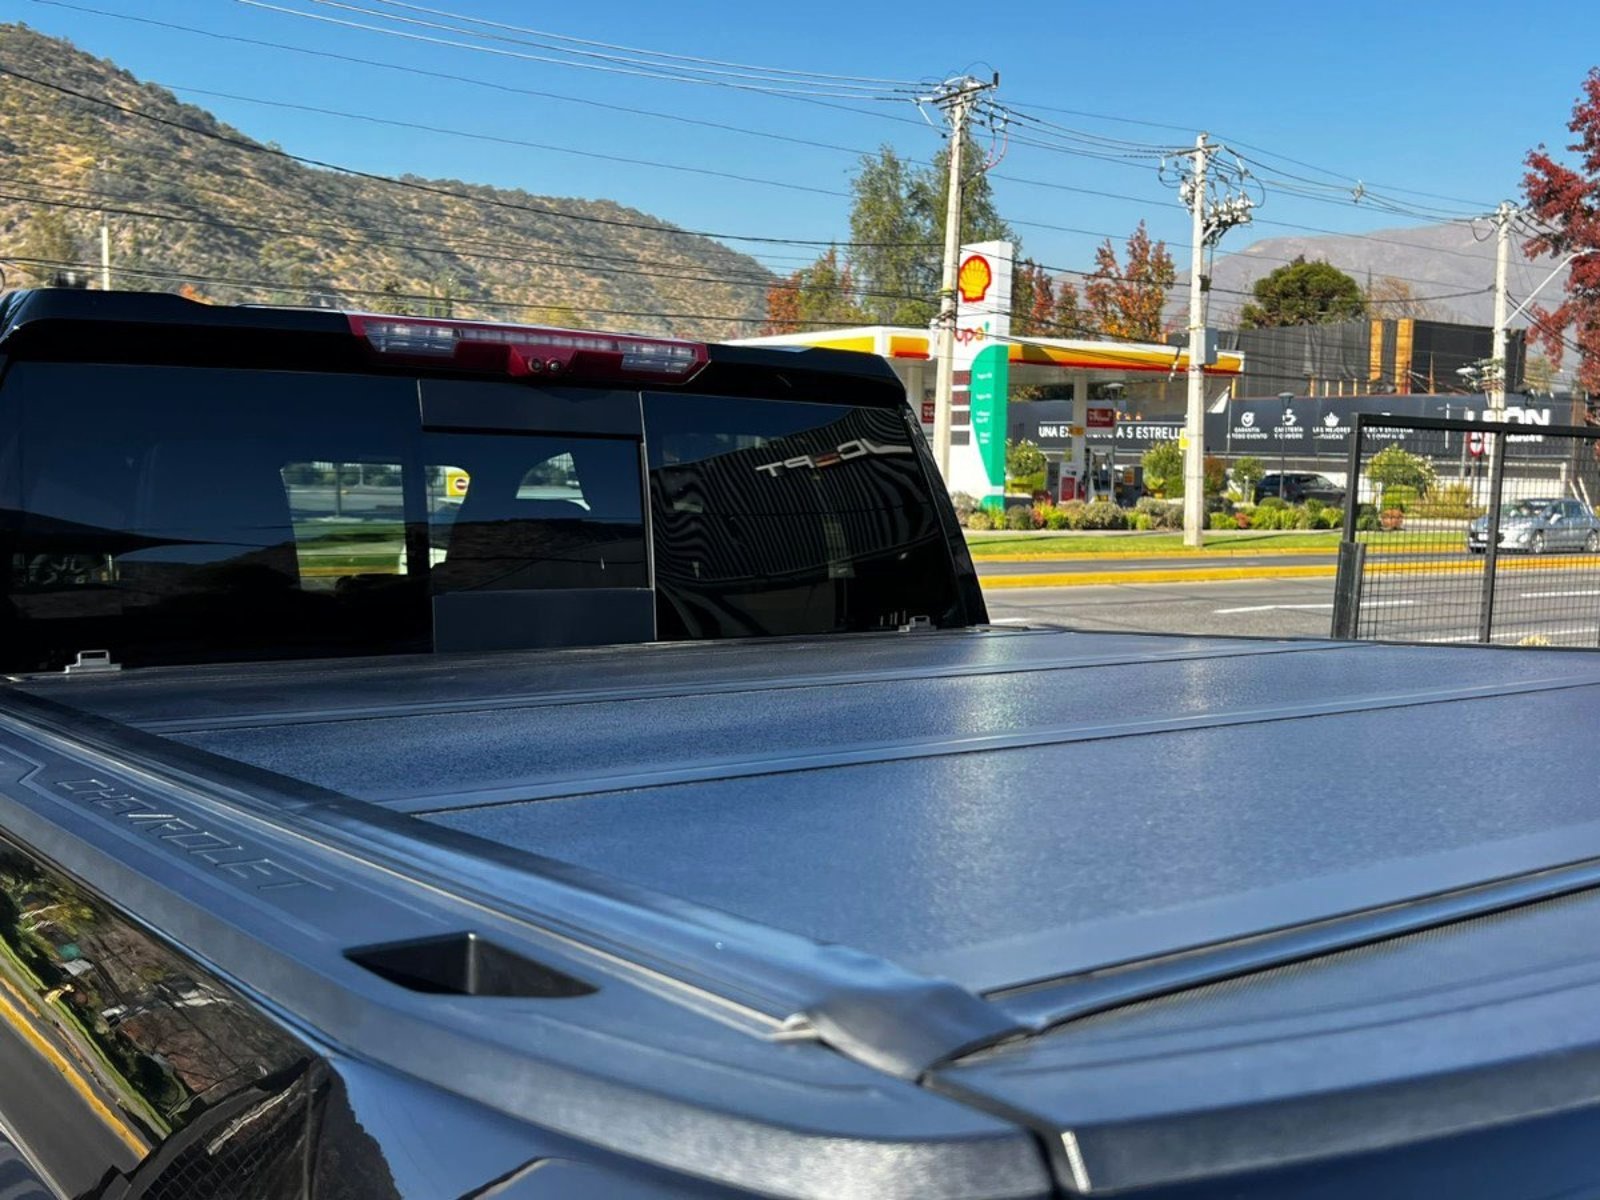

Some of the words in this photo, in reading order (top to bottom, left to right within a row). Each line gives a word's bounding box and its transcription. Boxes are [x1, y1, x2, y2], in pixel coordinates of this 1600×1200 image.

[1038, 426, 1057, 438] UNA
[1135, 427, 1180, 440] ESTRELL
[55, 778, 334, 891] CHEVROLET
